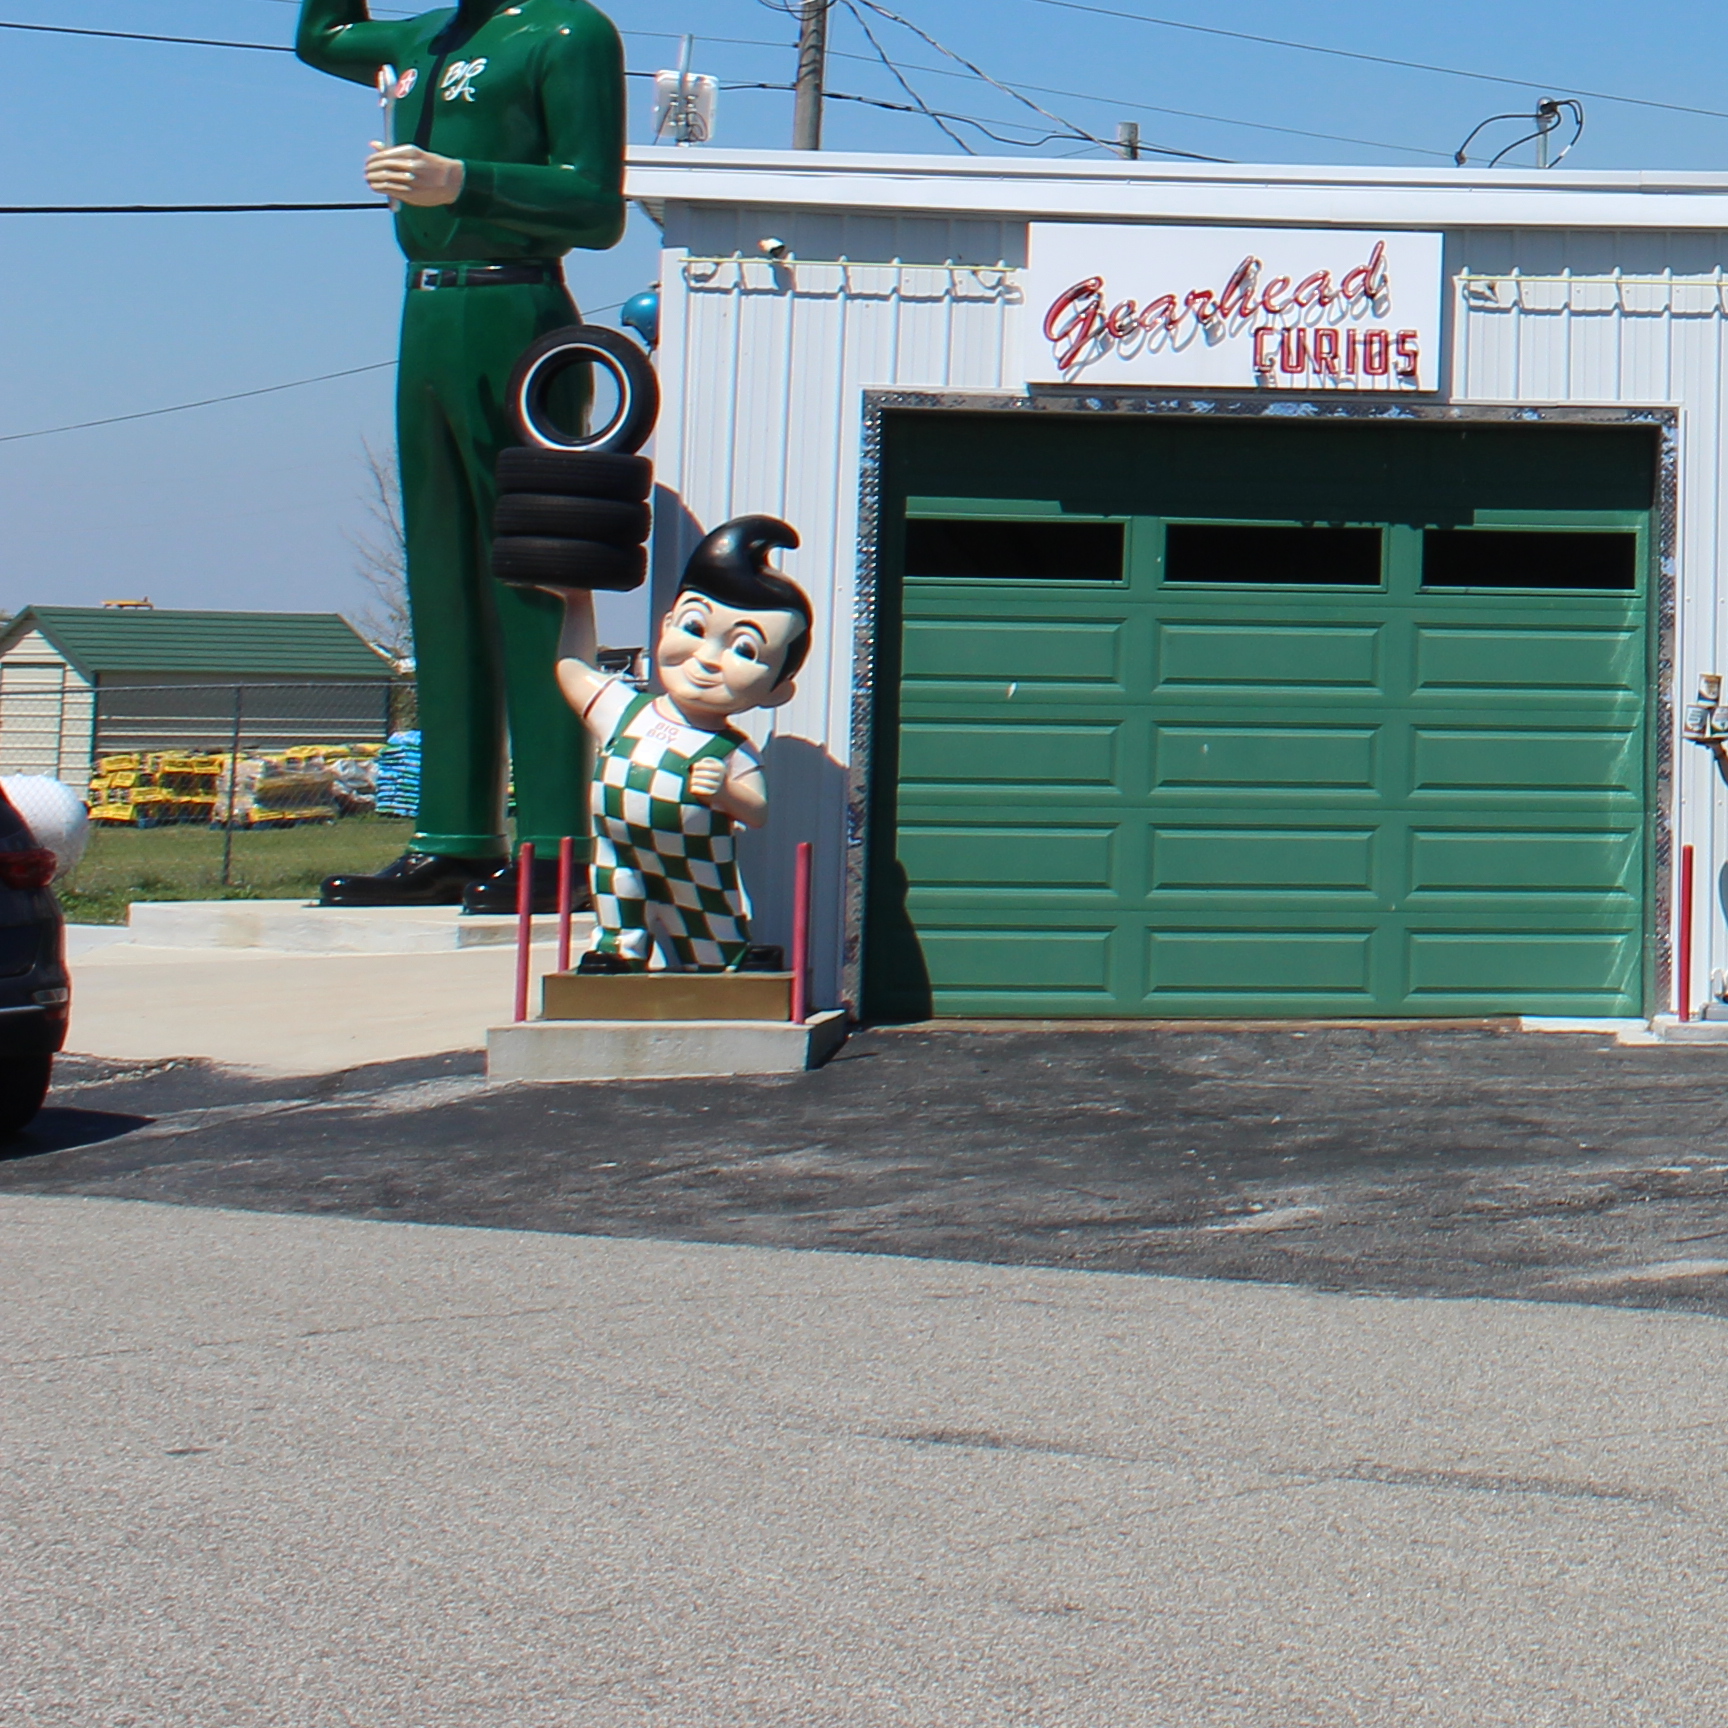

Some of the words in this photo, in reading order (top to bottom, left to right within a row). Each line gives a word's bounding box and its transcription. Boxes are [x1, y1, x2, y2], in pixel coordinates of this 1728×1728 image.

[1043, 239, 1387, 371] Gearhead
[1253, 326, 1420, 377] CURIOS
[646, 728, 677, 744] BOY
